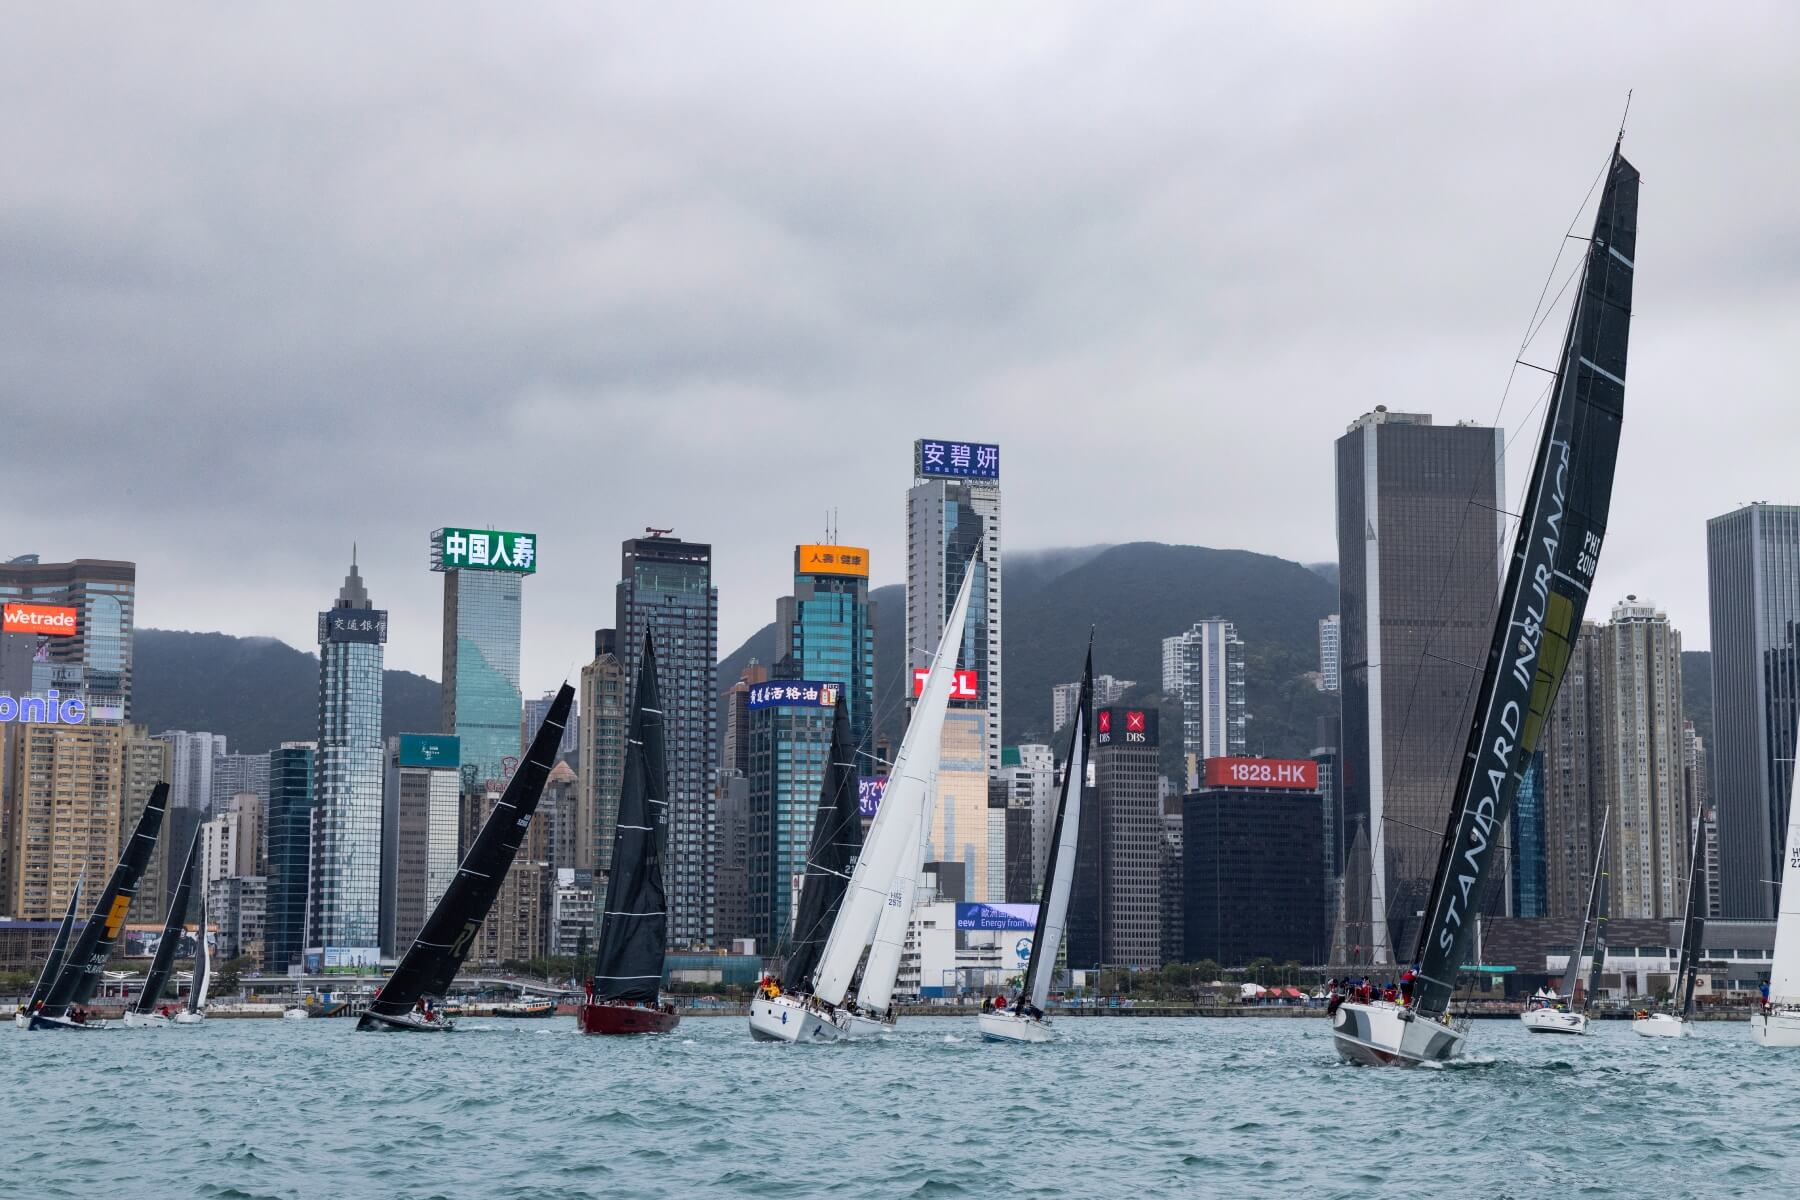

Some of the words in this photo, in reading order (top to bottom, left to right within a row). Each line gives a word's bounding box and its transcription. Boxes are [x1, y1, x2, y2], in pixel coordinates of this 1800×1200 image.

[924, 442, 998, 470] 安碧妍
[446, 531, 535, 569] 中国人寿
[1126, 732, 1146, 742] DBS
[1230, 763, 1305, 783] 1828.HK
[1440, 700, 1520, 957] STANDARD
[957, 919, 976, 928] eew
[981, 918, 1006, 929] Energy
[1007, 918, 1025, 928] from
